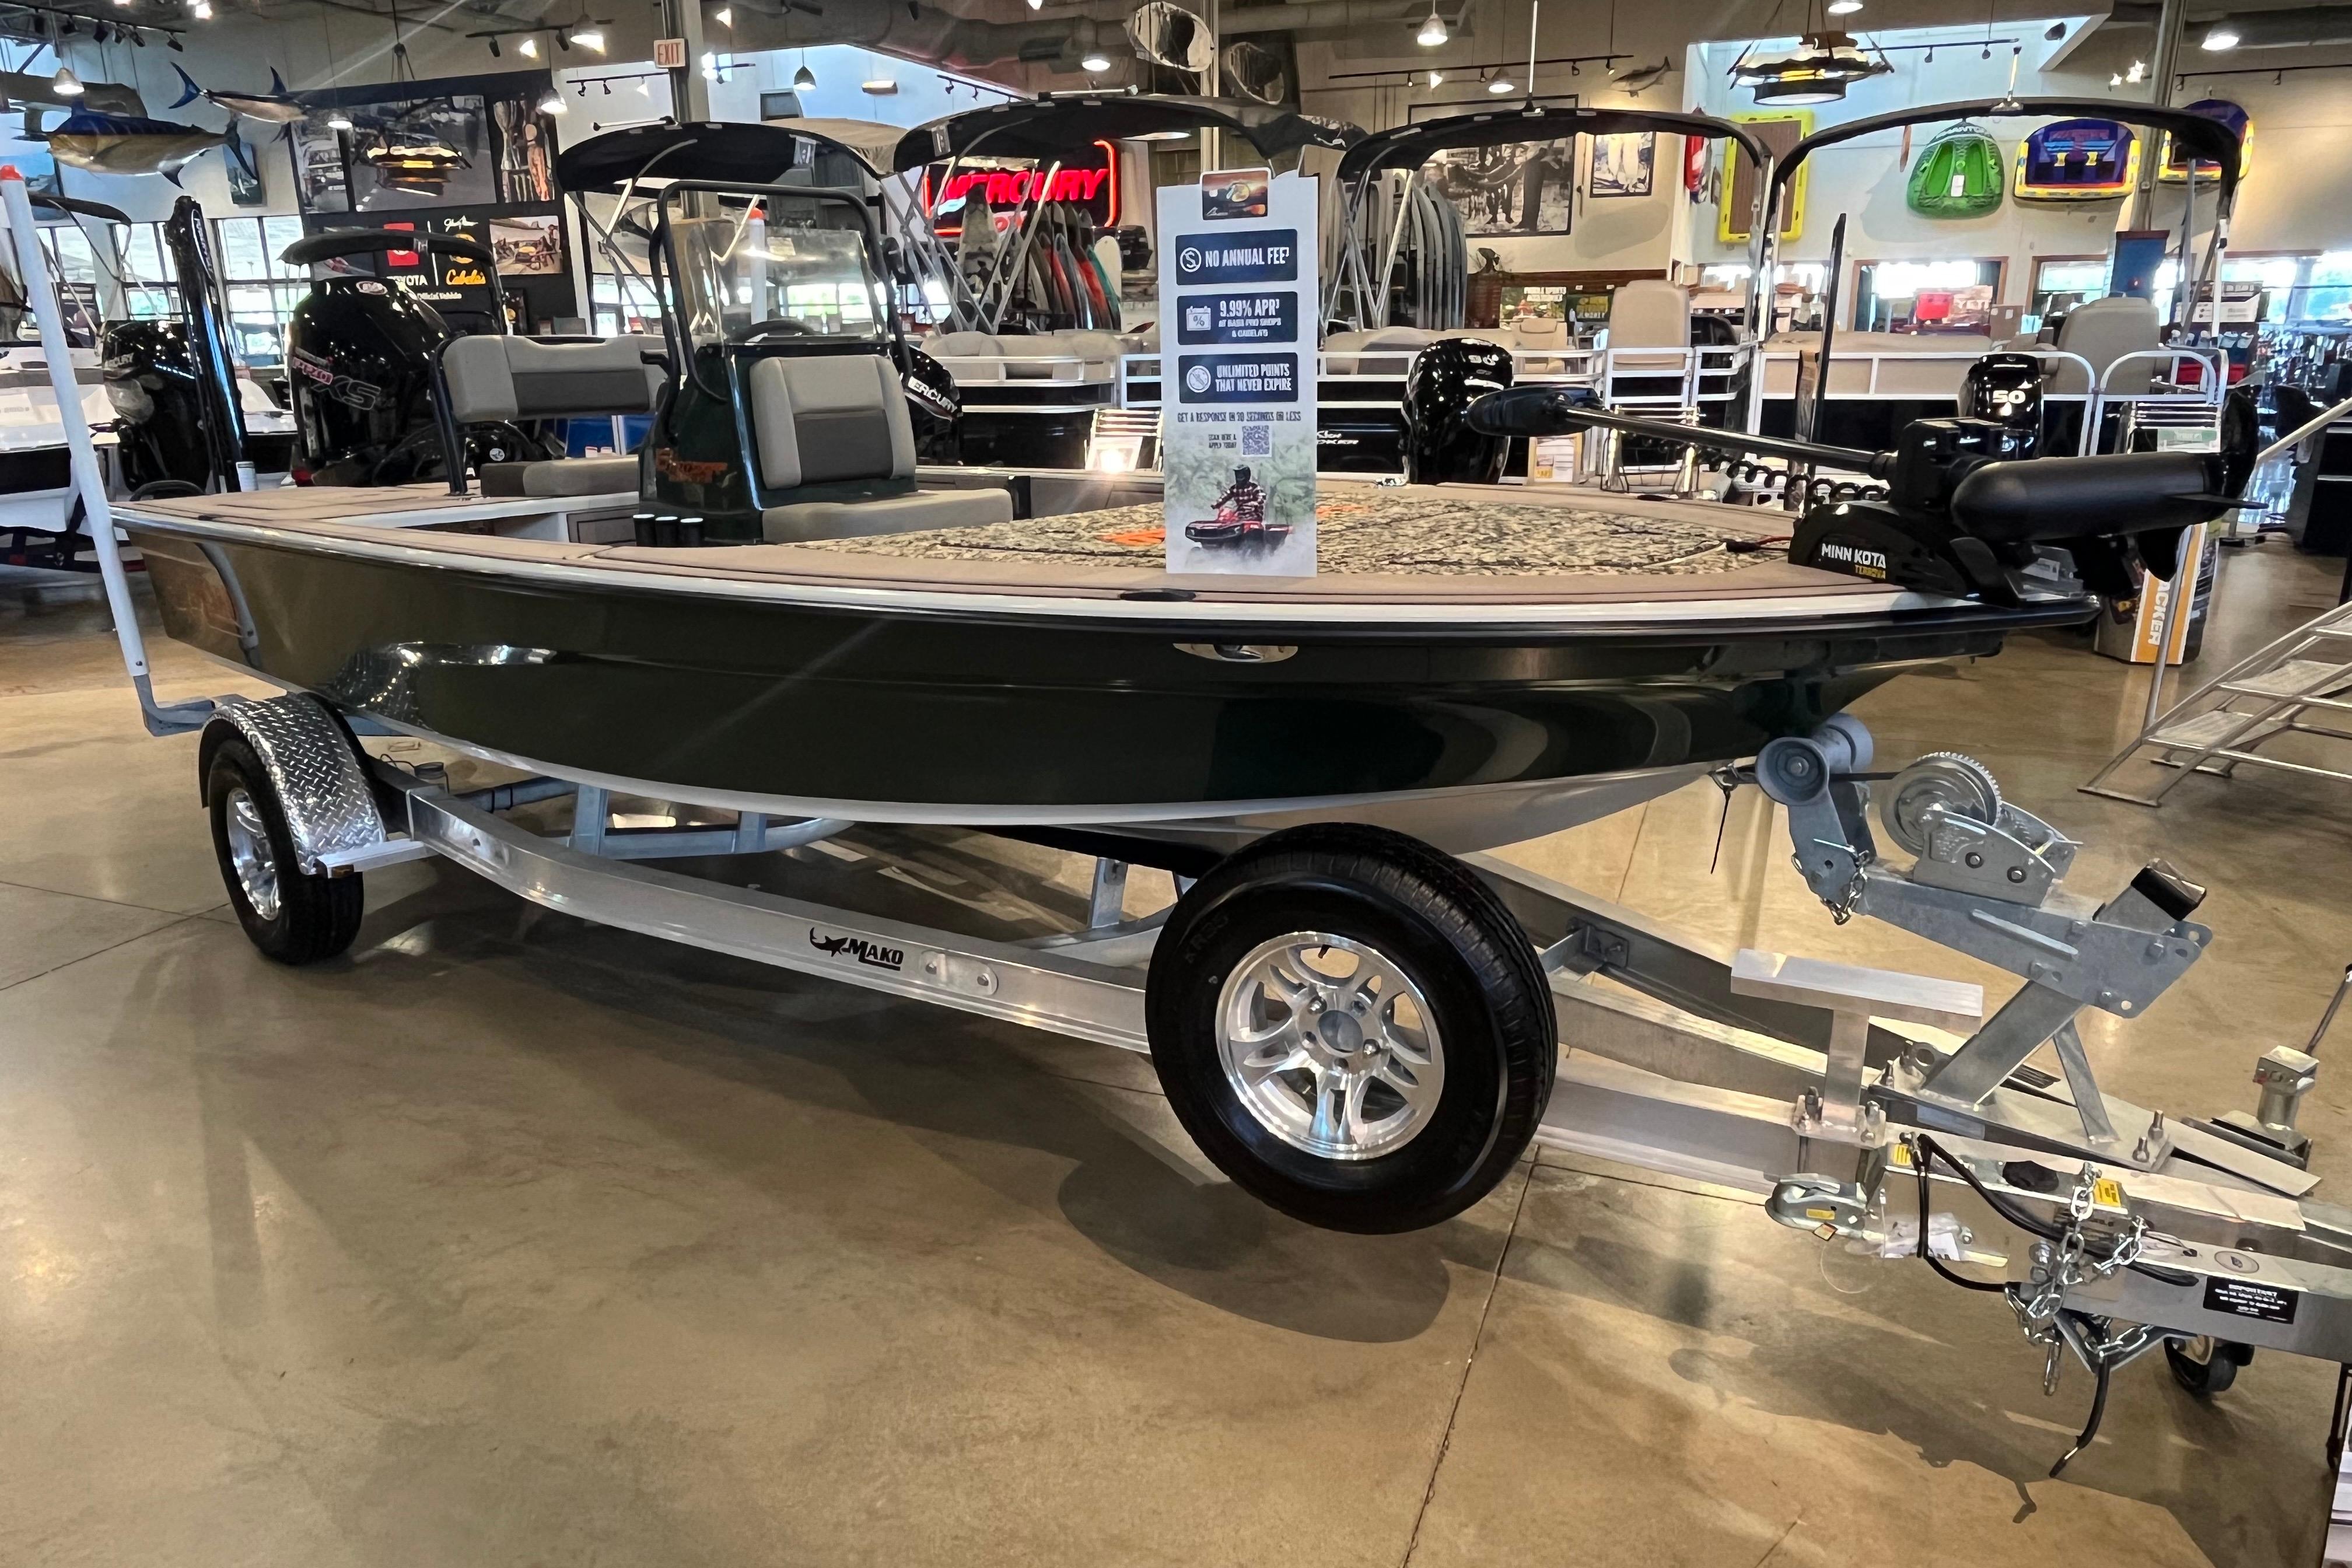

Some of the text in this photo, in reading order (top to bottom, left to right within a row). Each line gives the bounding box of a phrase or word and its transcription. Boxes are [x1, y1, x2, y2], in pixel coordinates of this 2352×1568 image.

[657, 43, 681, 65] EXIT
[1205, 250, 1220, 268] NO
[1222, 247, 1265, 267] ANNUAL
[387, 275, 428, 286] TYOTA
[1220, 299, 1252, 317] 9.99%
[1216, 363, 1290, 378] UNLIMITED POINTS
[1215, 377, 1292, 392] THAT NEVER EXPIRE
[1993, 390, 2026, 404] 50
[1821, 542, 1887, 569] MINN KOTA
